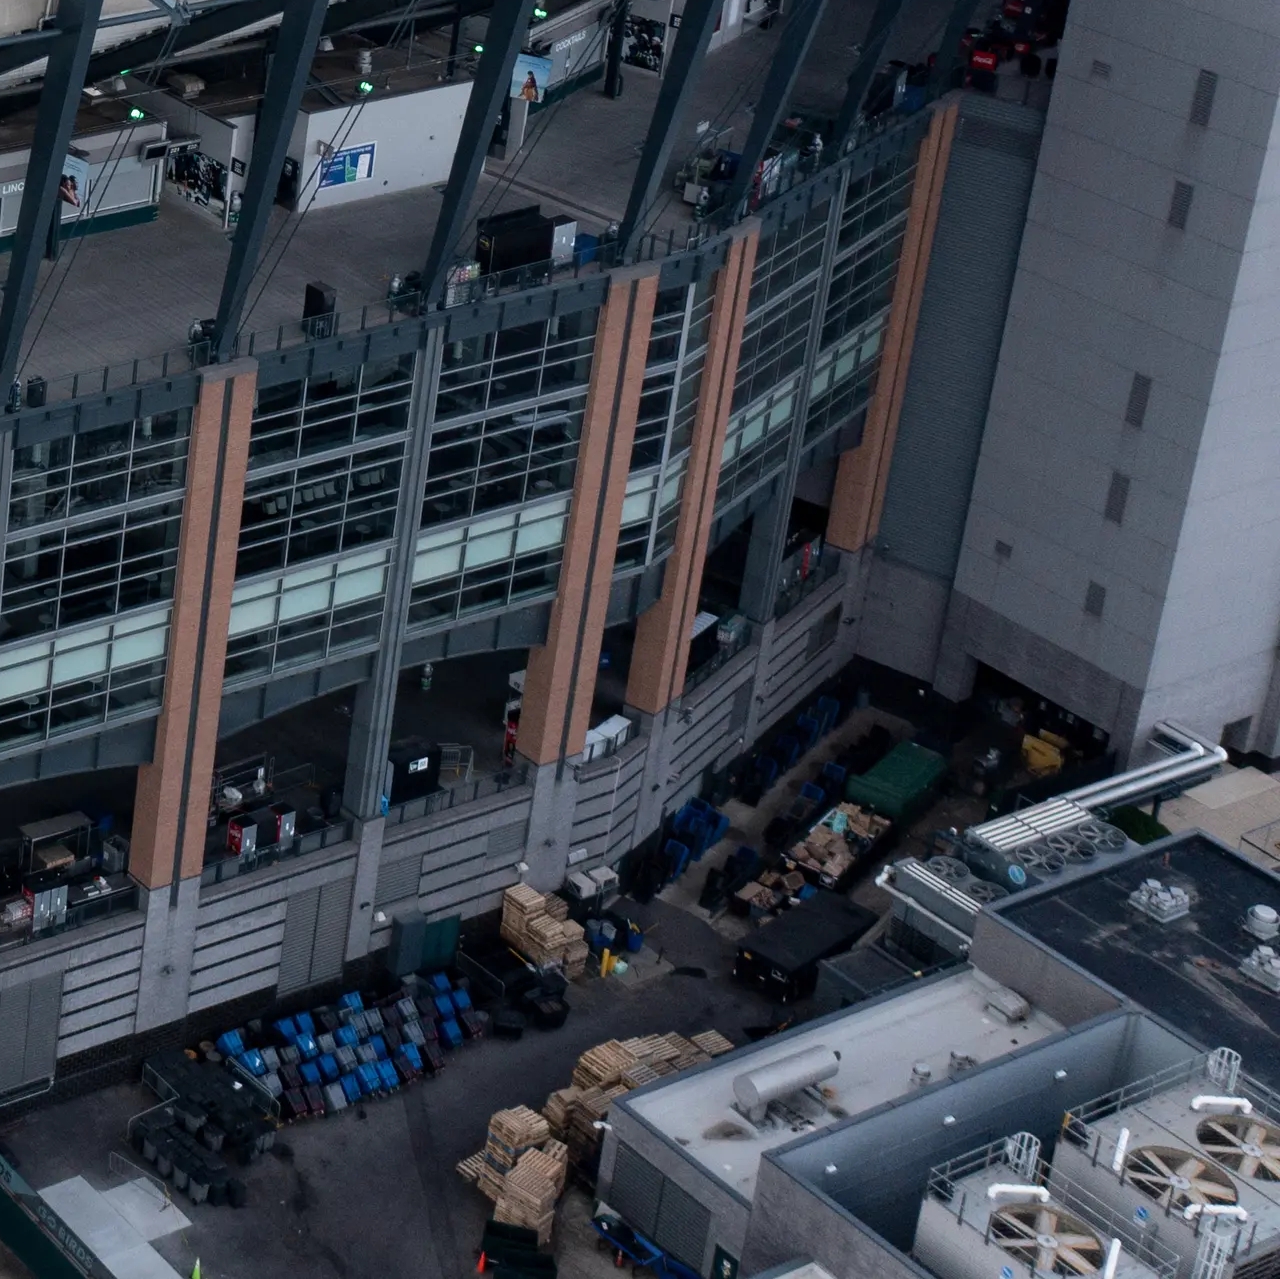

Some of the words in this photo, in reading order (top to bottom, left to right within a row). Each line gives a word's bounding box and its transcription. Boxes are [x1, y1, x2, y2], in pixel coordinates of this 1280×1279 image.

[555, 30, 587, 53] COCKTAILS
[37, 1205, 58, 1229] GO
[58, 1225, 94, 1269] BIRDS
